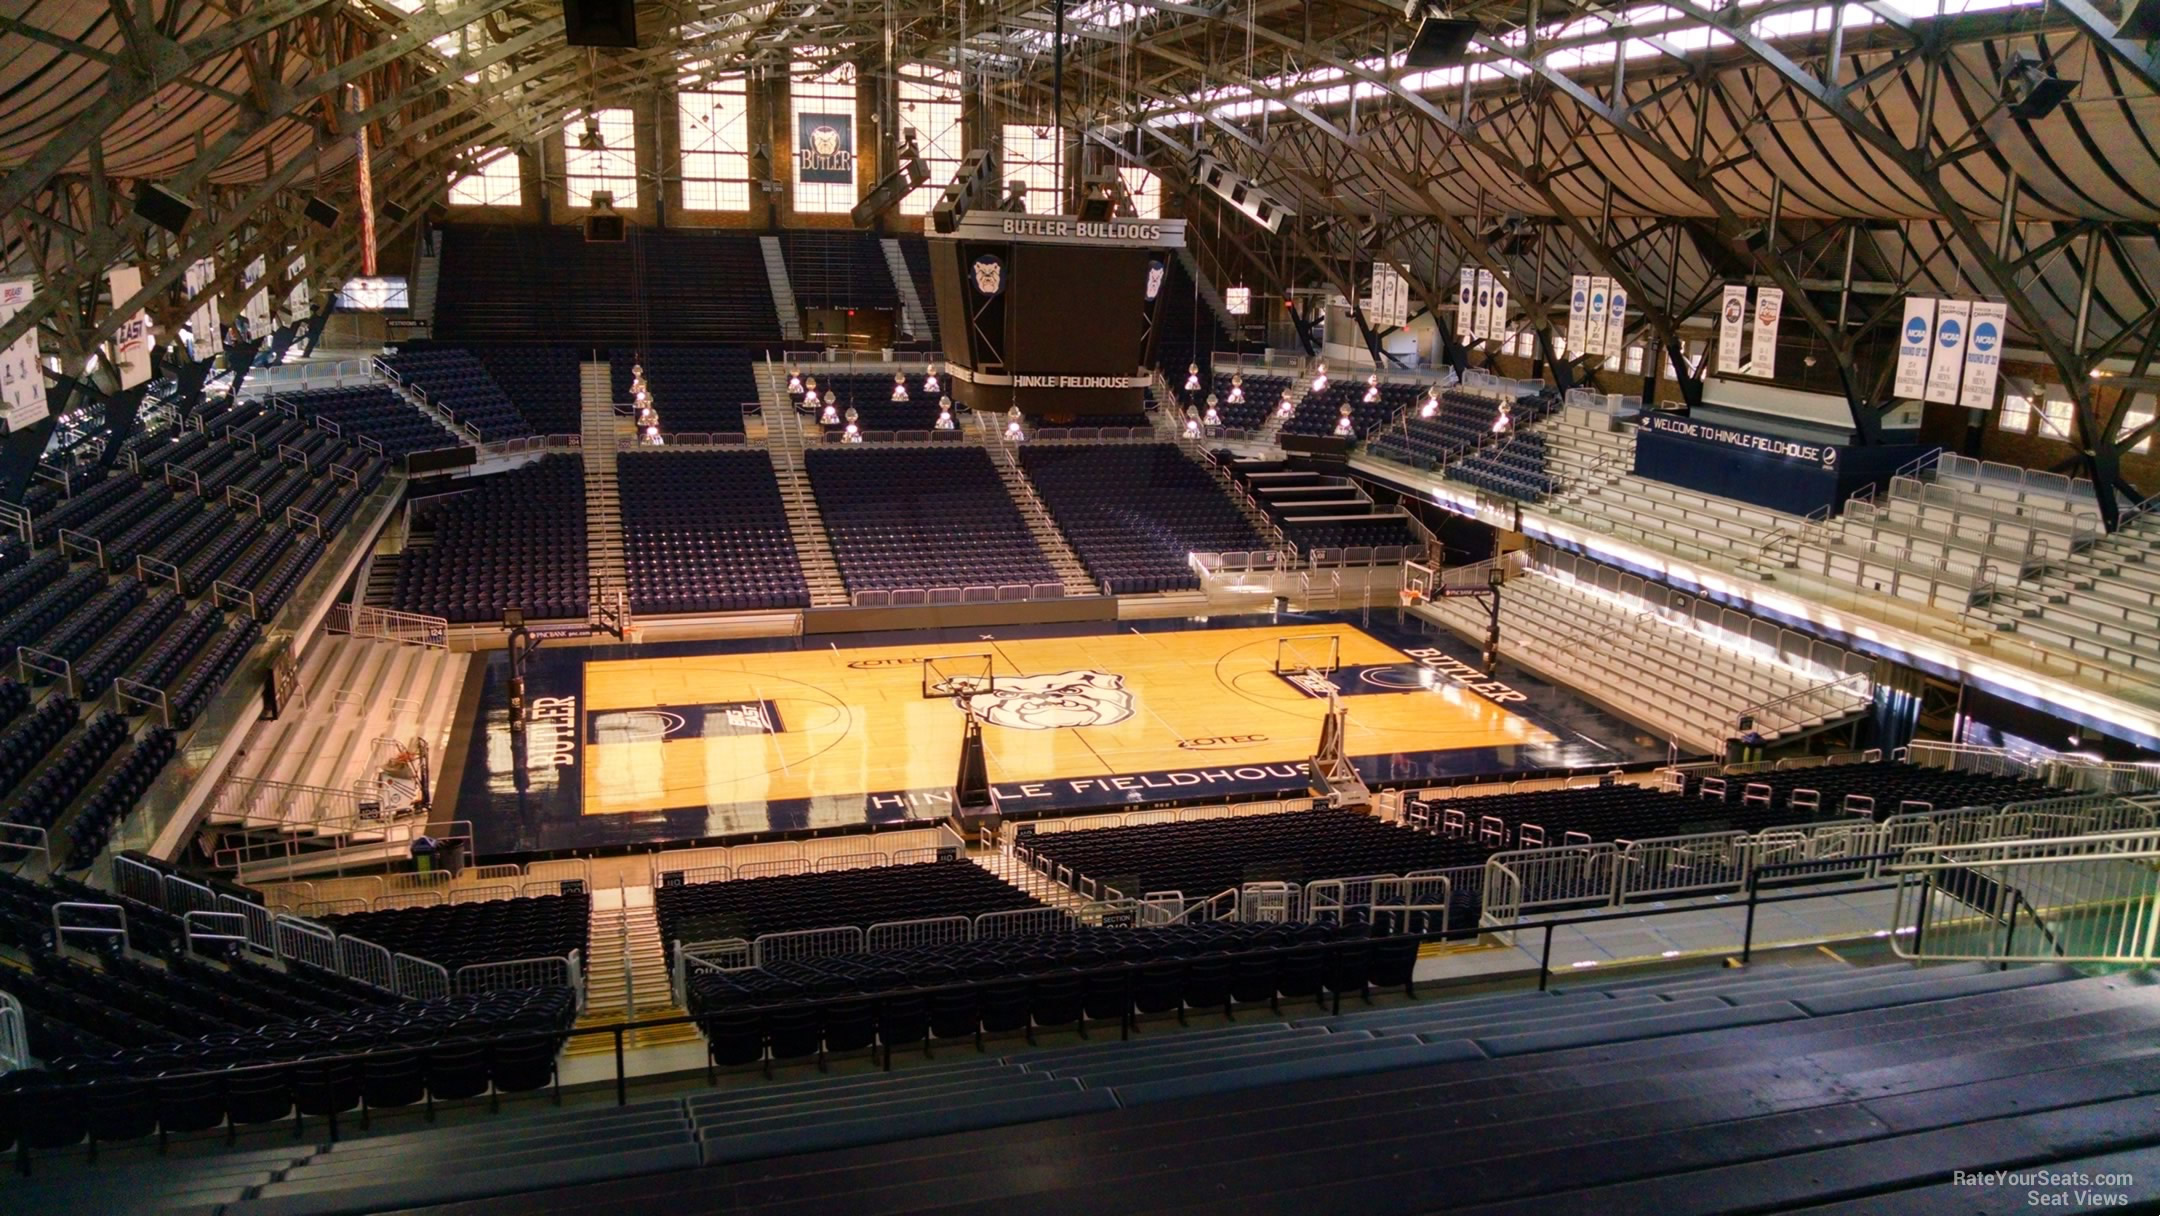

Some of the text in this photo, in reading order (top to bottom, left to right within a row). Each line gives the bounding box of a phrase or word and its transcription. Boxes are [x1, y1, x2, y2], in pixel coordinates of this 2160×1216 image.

[800, 149, 851, 171] BUTLER
[1003, 218, 1161, 240] BUTLER BULLDOGS
[120, 320, 143, 343] EAST
[1014, 375, 1129, 388] HINKLE FIELDHOUSE
[1653, 417, 1820, 461] WELCOME TO HINKLE FIELDHOUSE
[1402, 647, 1528, 703] BUTLER
[526, 695, 576, 768] BUTLER
[872, 782, 1052, 809] HINLE
[1103, 915, 1131, 924] SECTION
